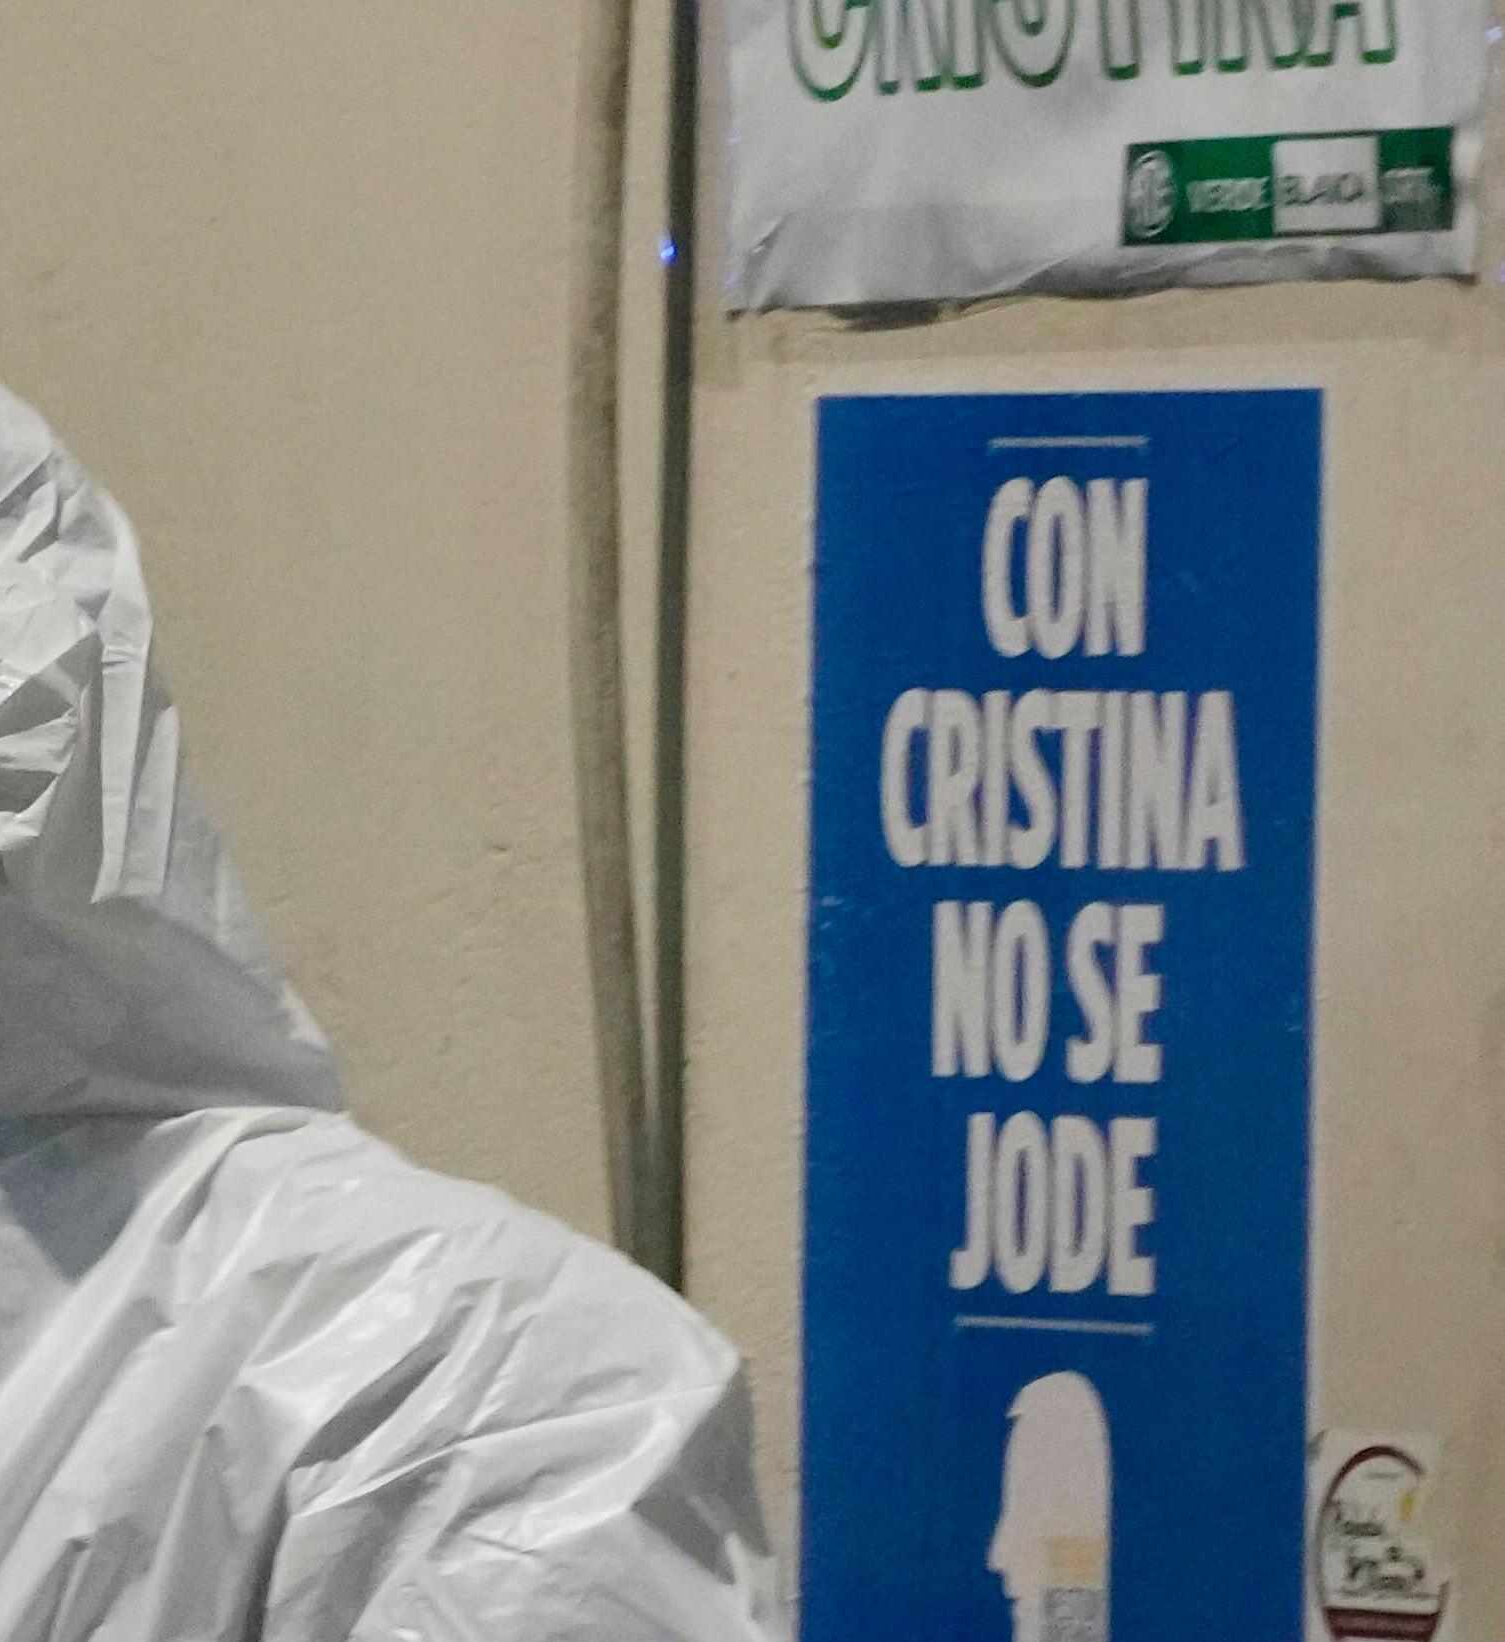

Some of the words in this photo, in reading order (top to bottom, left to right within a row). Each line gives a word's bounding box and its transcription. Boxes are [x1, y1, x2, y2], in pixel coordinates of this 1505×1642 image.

[982, 474, 1149, 658] CON
[879, 686, 1246, 872] CRISTINA
[931, 899, 1053, 1083] NO
[1064, 902, 1165, 1085] SE
[948, 1110, 1160, 1298] JODE
